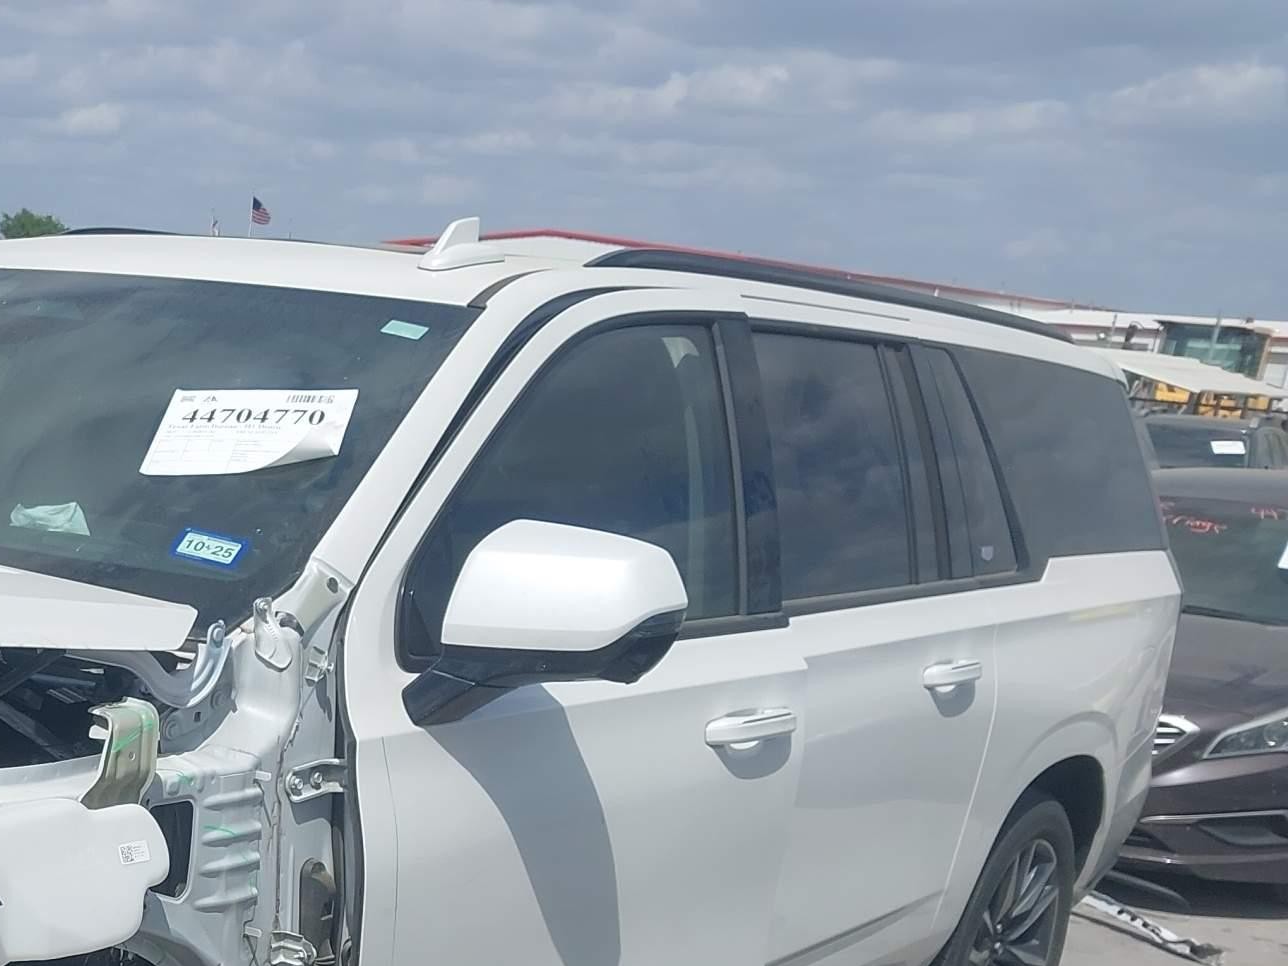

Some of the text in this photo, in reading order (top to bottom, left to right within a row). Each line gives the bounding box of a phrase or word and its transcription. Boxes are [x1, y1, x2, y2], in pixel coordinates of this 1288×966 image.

[181, 408, 326, 426] 44704770
[185, 538, 235, 559] 10 25
